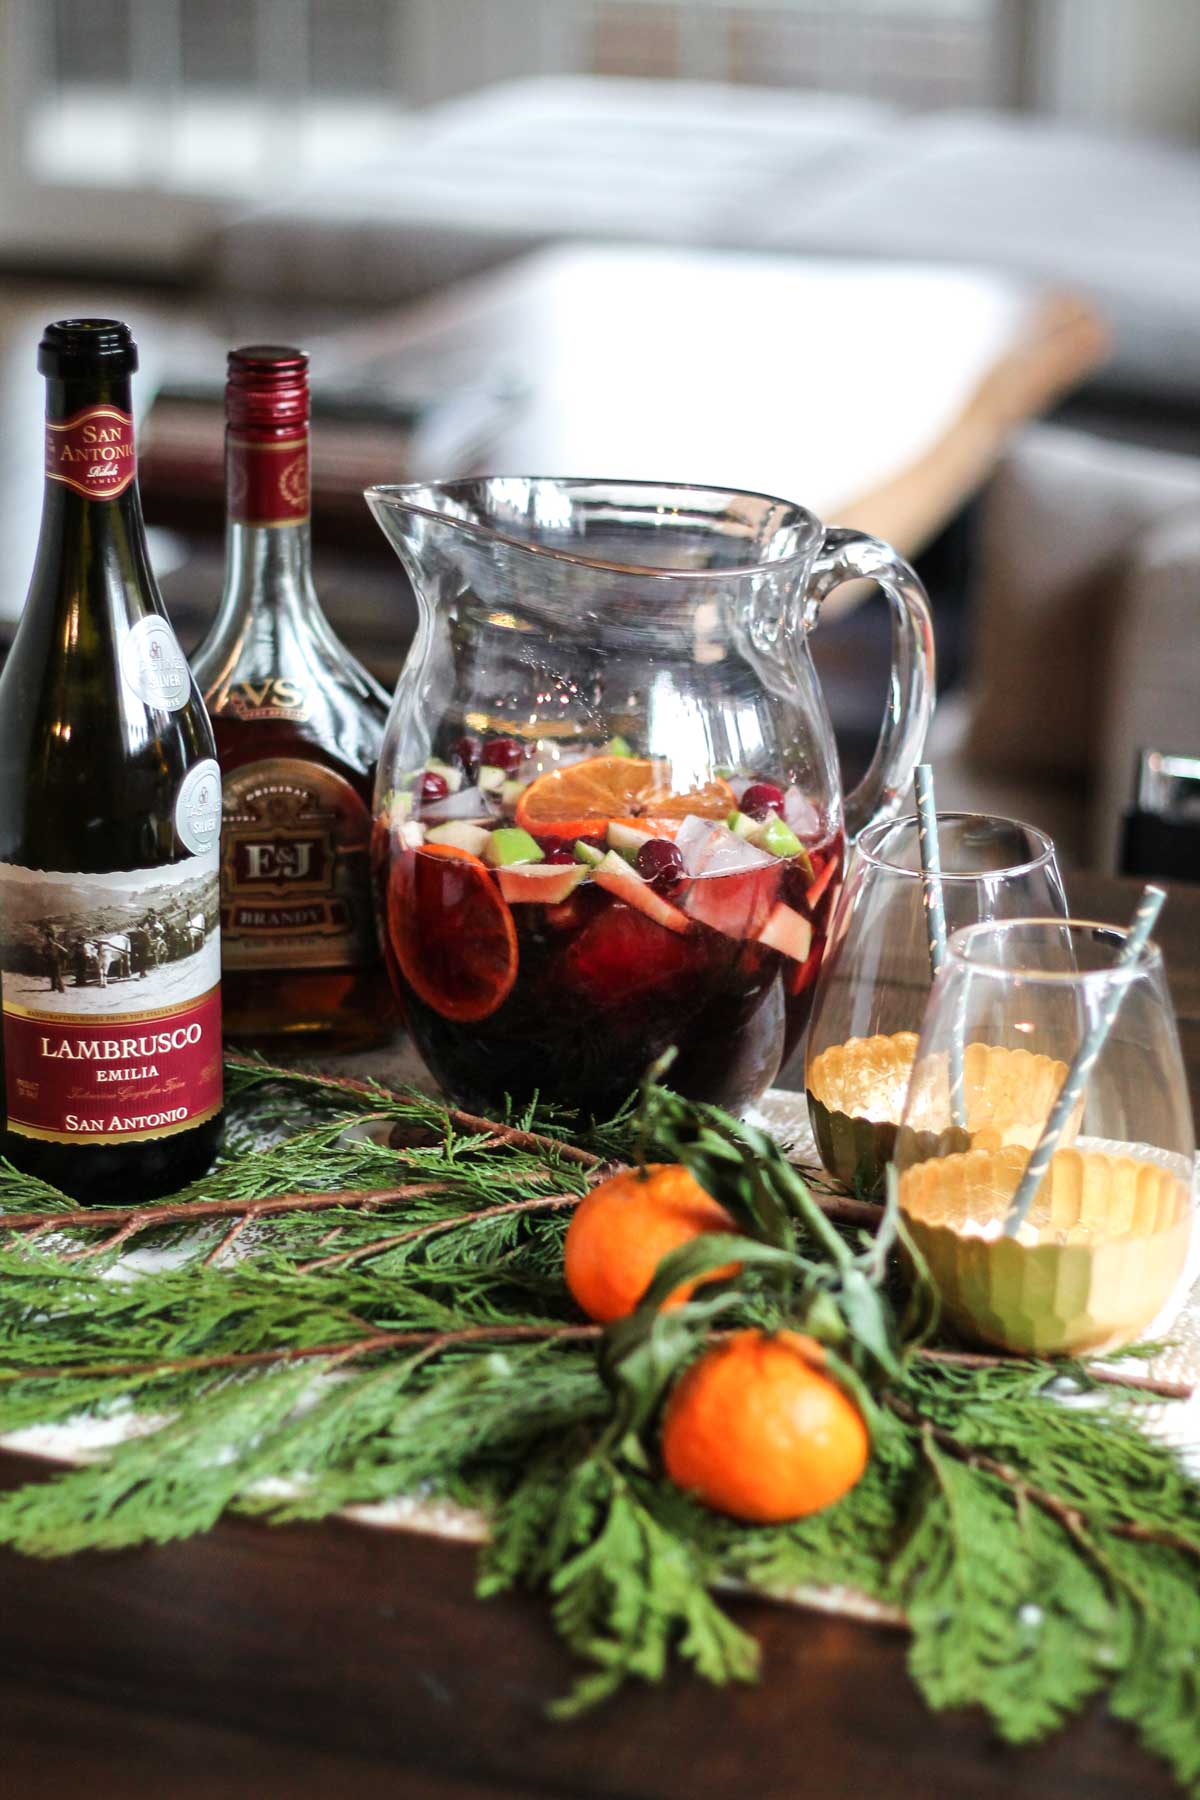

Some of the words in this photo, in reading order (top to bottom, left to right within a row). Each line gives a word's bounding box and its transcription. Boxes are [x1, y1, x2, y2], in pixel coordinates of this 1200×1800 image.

[82, 425, 122, 444] SAN
[246, 785, 310, 801] ORIGINAL
[245, 842, 314, 878] E&J
[240, 910, 319, 925] BRANDY
[40, 1023, 202, 1060] LAMBRUSCO
[96, 1065, 159, 1082] EMILIA
[65, 1114, 105, 1131] SAN
[107, 1106, 188, 1131] ANTONIO
